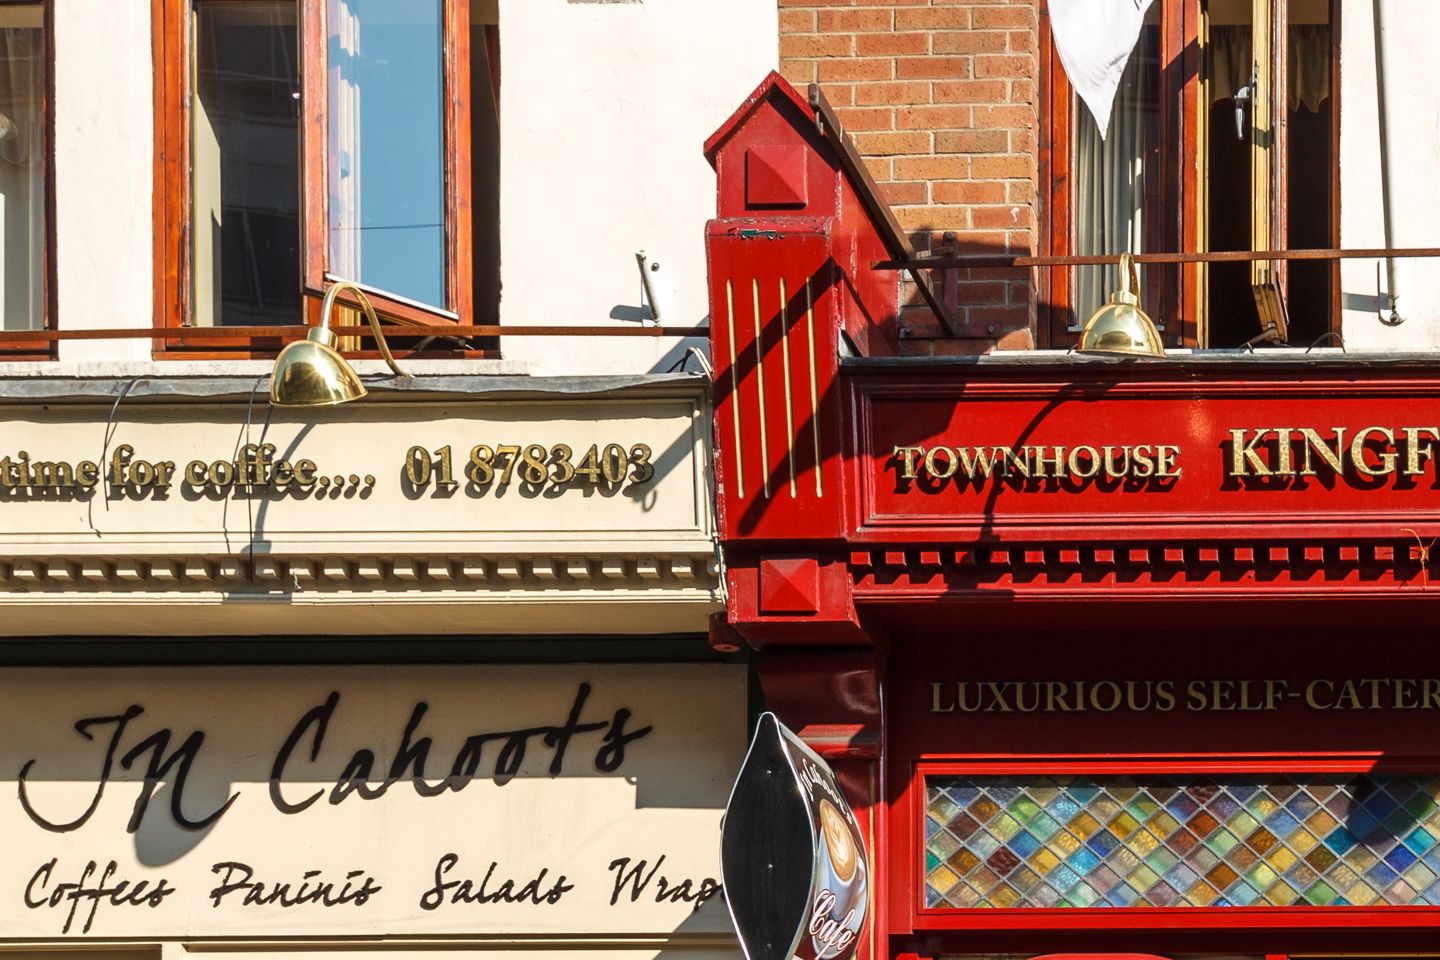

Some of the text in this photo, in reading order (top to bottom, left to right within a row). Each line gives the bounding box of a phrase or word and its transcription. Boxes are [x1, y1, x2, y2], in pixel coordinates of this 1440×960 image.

[0, 450, 99, 488] time
[110, 444, 175, 487] for
[405, 445, 457, 485] 01
[470, 443, 654, 484] 8783403
[893, 444, 1182, 479] TOWNHOUSE
[929, 680, 1176, 712] LUXURIOUS
[269, 681, 653, 815] Cahoots
[24, 853, 723, 934] Coffees Paninis Salads Wrap
